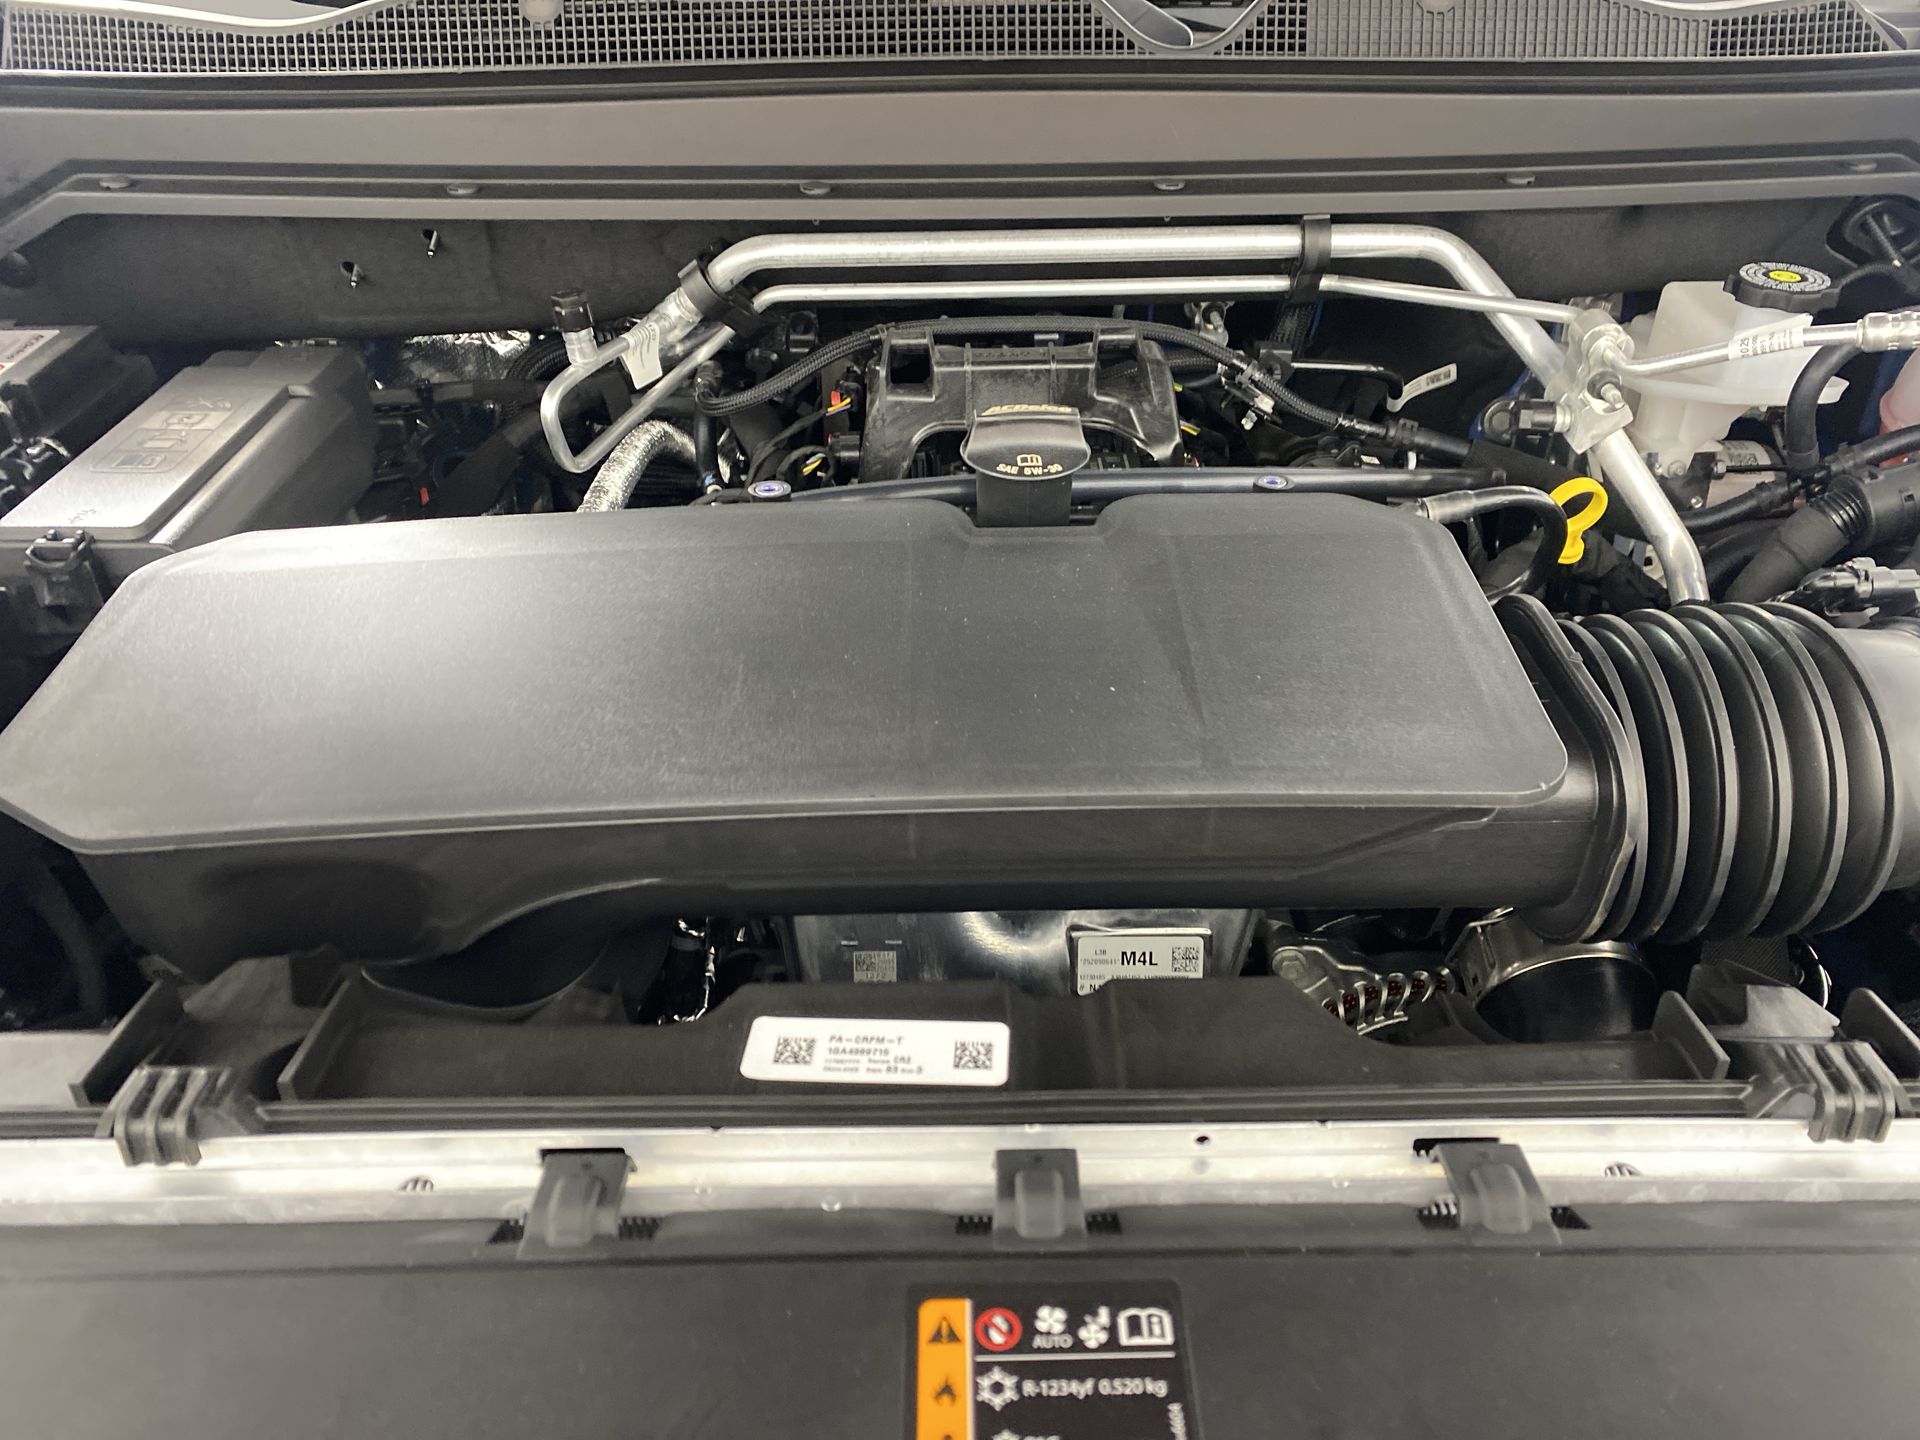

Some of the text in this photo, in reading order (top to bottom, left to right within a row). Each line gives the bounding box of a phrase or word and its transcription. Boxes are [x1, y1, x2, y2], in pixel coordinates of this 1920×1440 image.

[996, 463, 1063, 475] SAE 5W-30
[1120, 951, 1158, 966] M4L
[1032, 1334, 1073, 1349] AUTO
[1021, 1376, 1168, 1399] R-1234yf 0.520 kg
